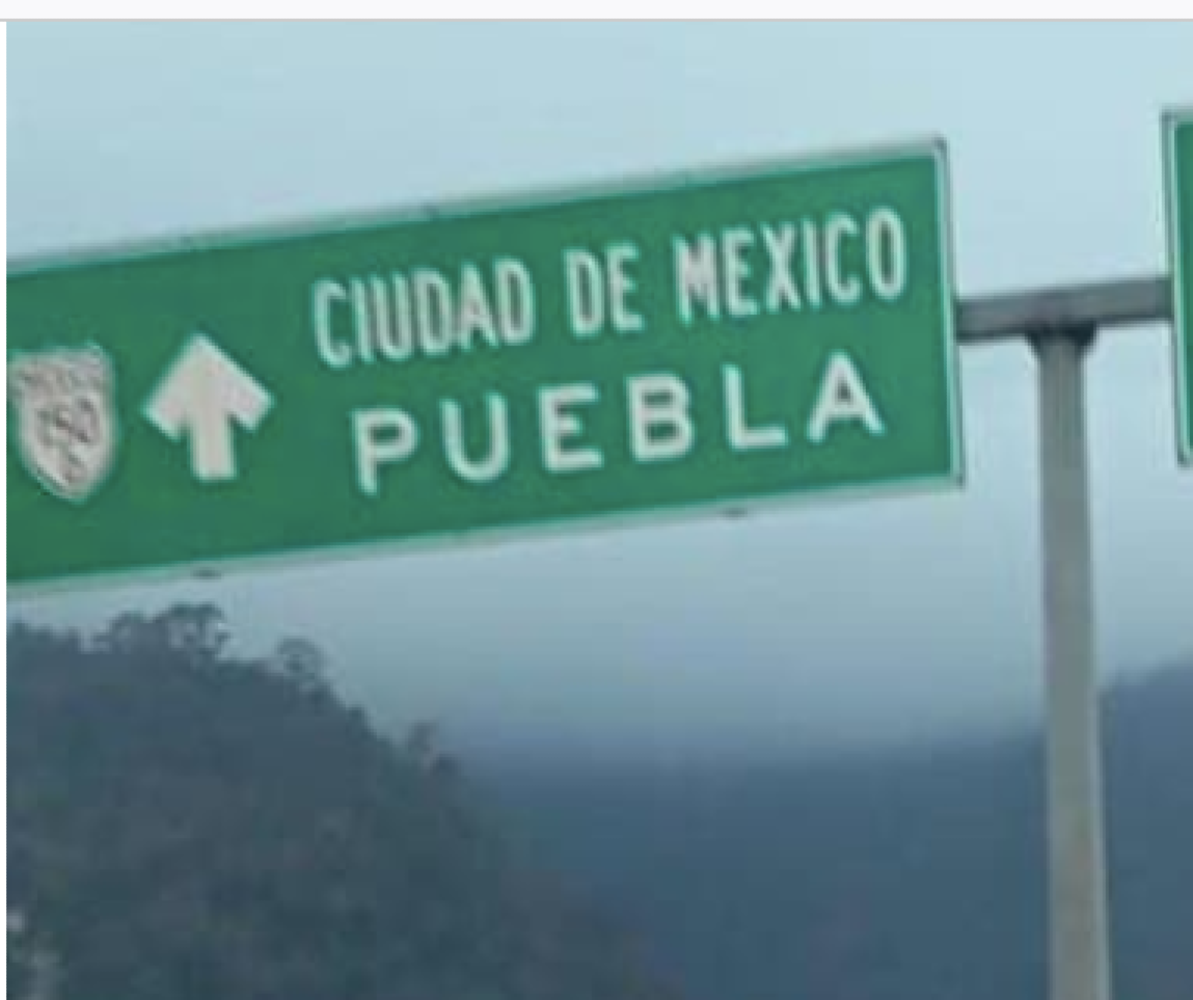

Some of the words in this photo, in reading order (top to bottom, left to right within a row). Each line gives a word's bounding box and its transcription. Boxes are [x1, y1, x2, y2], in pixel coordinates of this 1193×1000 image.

[313, 259, 534, 367] CIUDAD
[566, 246, 642, 334] DE
[676, 208, 907, 322] MEXICO
[352, 352, 884, 495] PUEBLA
